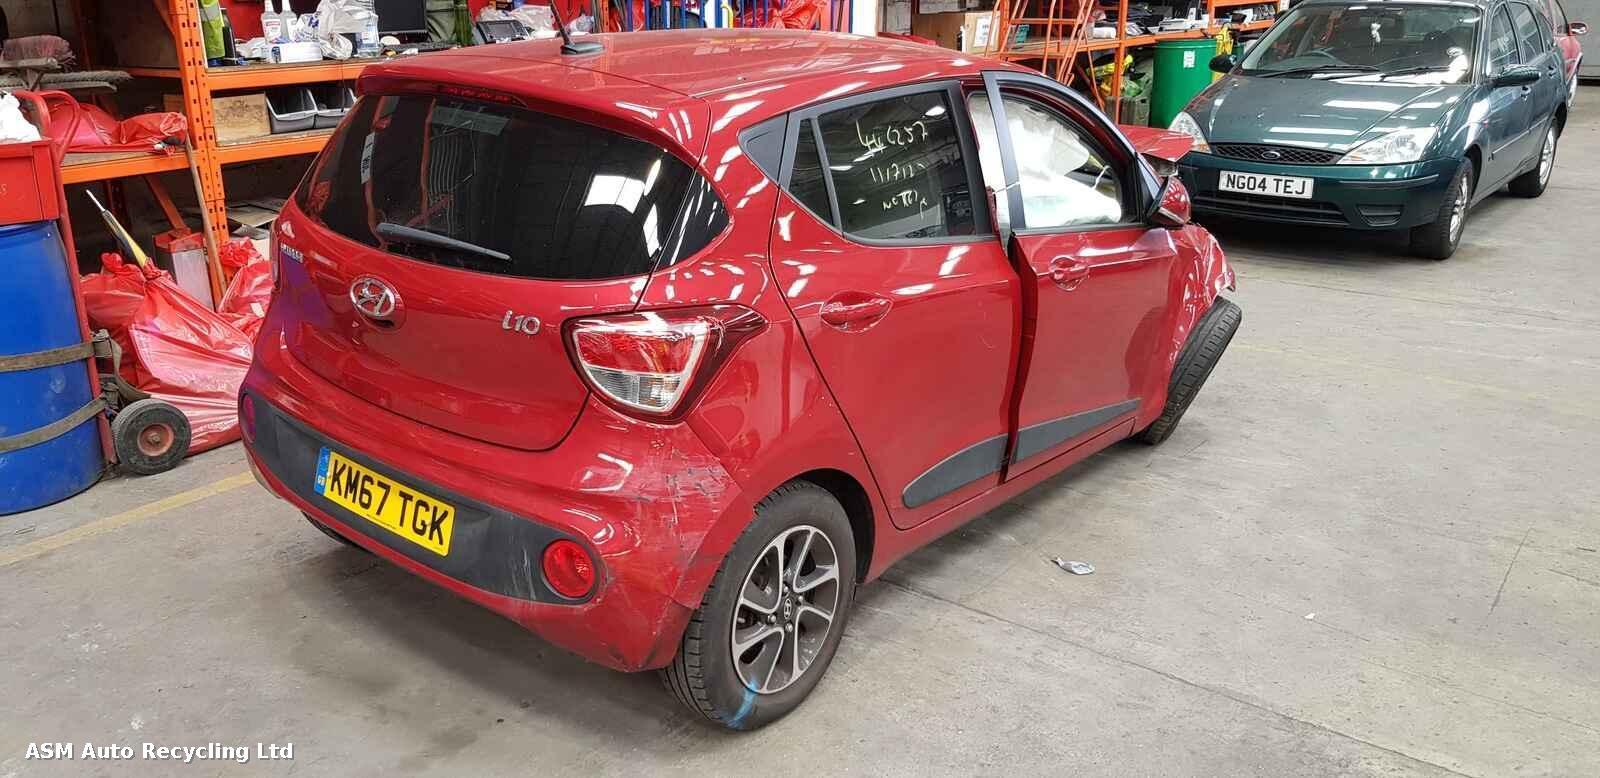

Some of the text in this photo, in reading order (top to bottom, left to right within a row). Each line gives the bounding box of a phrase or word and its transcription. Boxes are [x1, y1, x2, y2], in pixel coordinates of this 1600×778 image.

[1226, 173, 1306, 195] NG04 TEJ
[502, 310, 541, 335] i10
[330, 459, 449, 546] KM67 TGK
